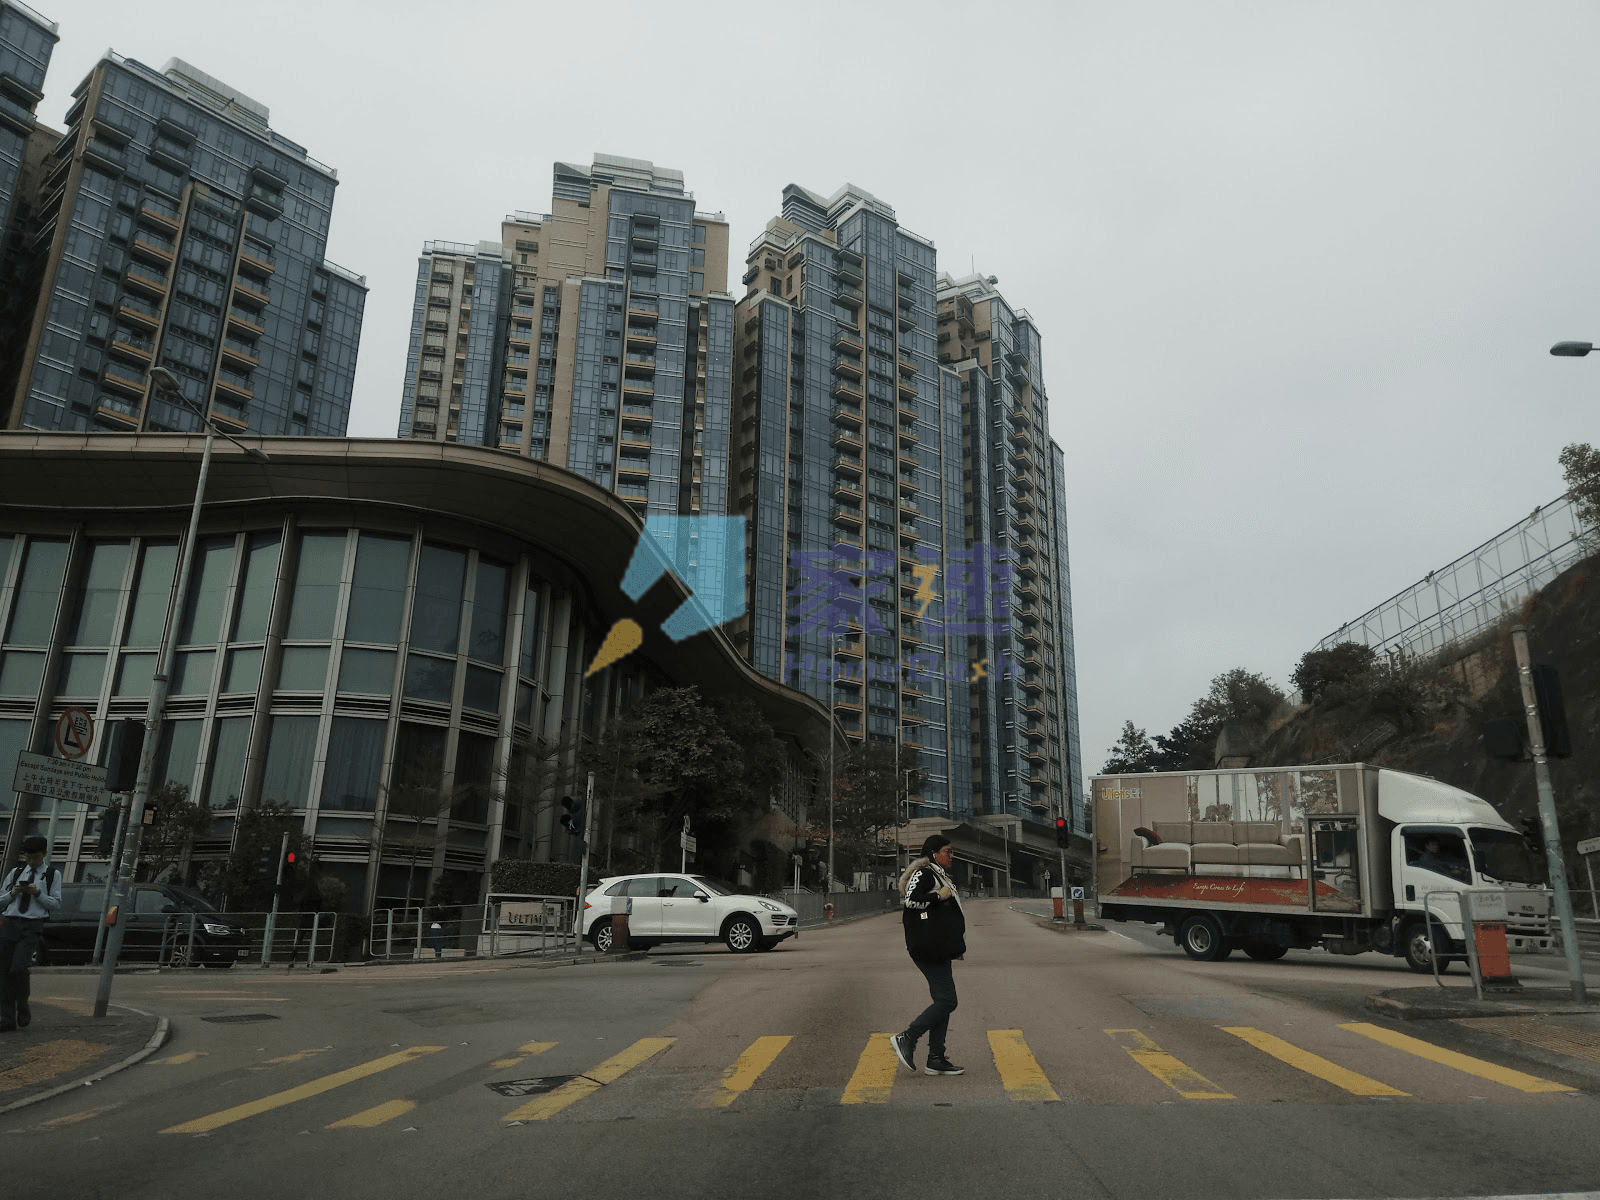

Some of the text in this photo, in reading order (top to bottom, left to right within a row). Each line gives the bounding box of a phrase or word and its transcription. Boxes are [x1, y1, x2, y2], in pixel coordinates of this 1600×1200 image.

[20, 760, 40, 770] Except
[39, 764, 62, 774] Sundays
[74, 771, 91, 780] Public
[47, 757, 58, 766] 7:30
[71, 762, 82, 771] 7:30
